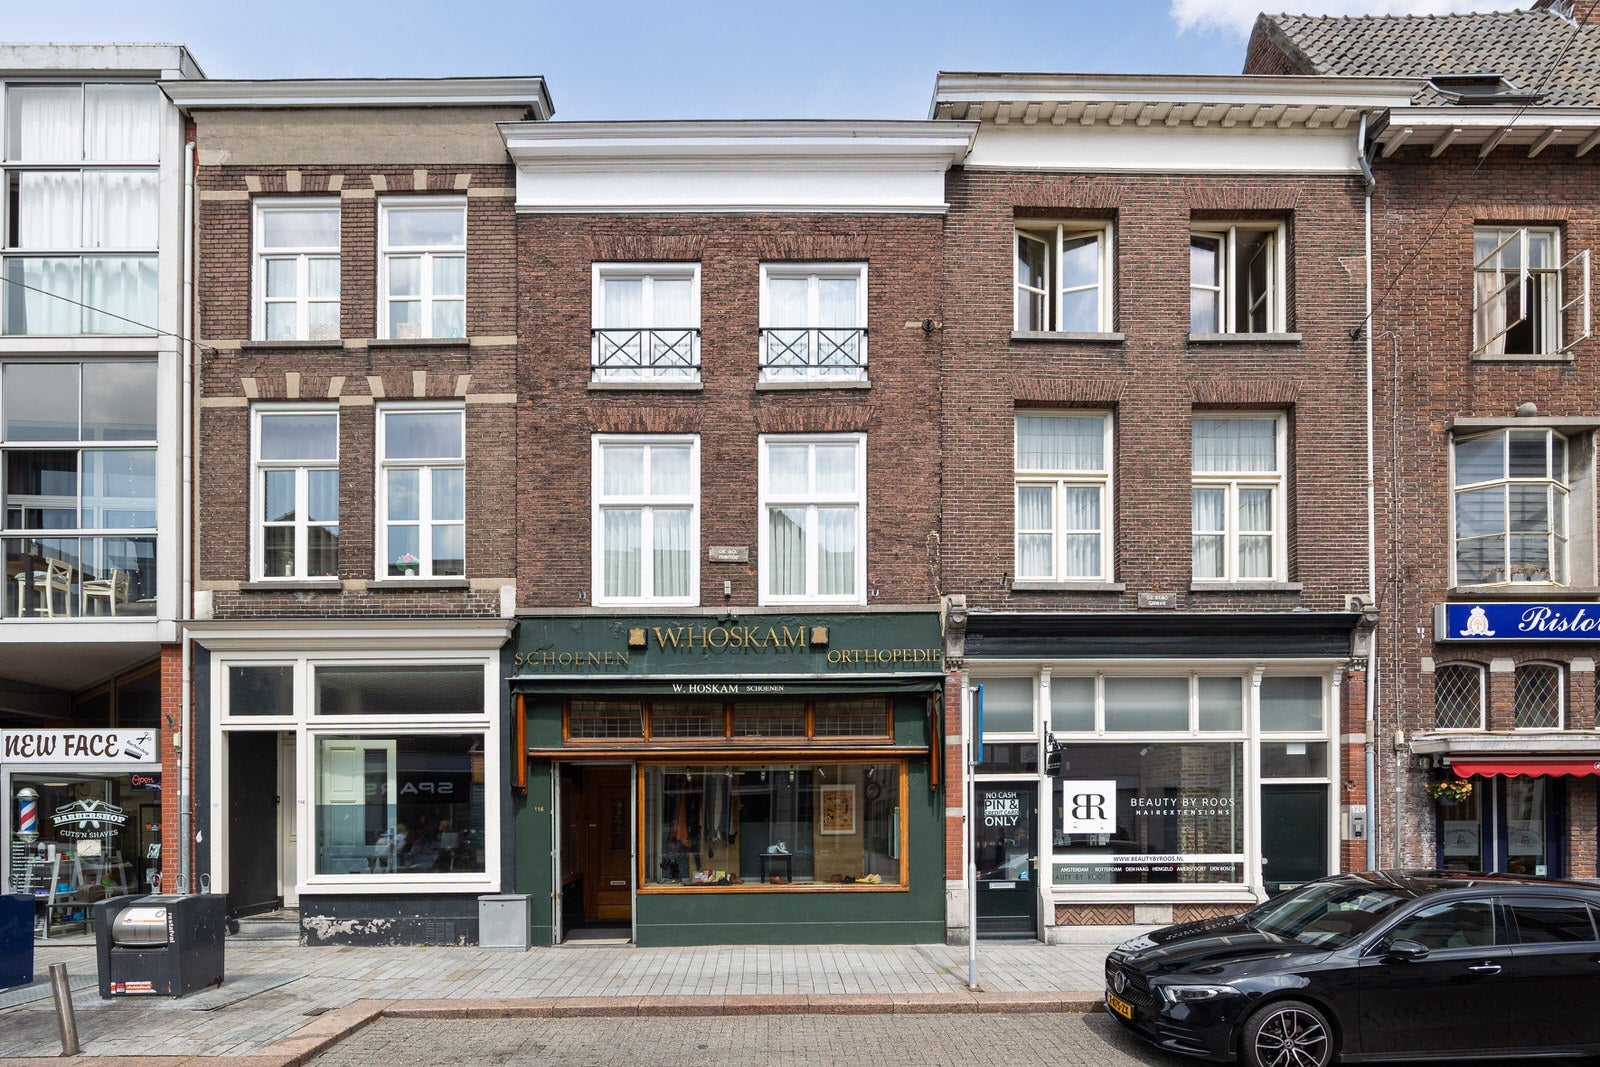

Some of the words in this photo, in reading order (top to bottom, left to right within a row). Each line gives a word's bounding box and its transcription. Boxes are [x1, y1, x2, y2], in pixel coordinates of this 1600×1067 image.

[1518, 606, 1600, 632] Risto
[514, 651, 630, 666] SCHOENEN
[827, 648, 942, 663] ORTHOPEDIE
[672, 684, 686, 693] W.
[689, 684, 739, 693] HOSKAM
[5, 734, 57, 758] NEW
[63, 734, 120, 758] FACE
[986, 791, 997, 799] NO
[998, 791, 1017, 799] CASH
[984, 800, 1006, 810] PIN
[1009, 800, 1018, 810] &
[1130, 797, 1177, 807] BEAUTY
[1182, 797, 1197, 807] BY
[1202, 797, 1235, 807] ROOS
[1352, 804, 1366, 813] 120
[53, 812, 126, 824] BARBERSHOP
[984, 816, 1019, 827] ONLY
[89, 829, 119, 839] SHAVES
[168, 912, 176, 944] restafval
